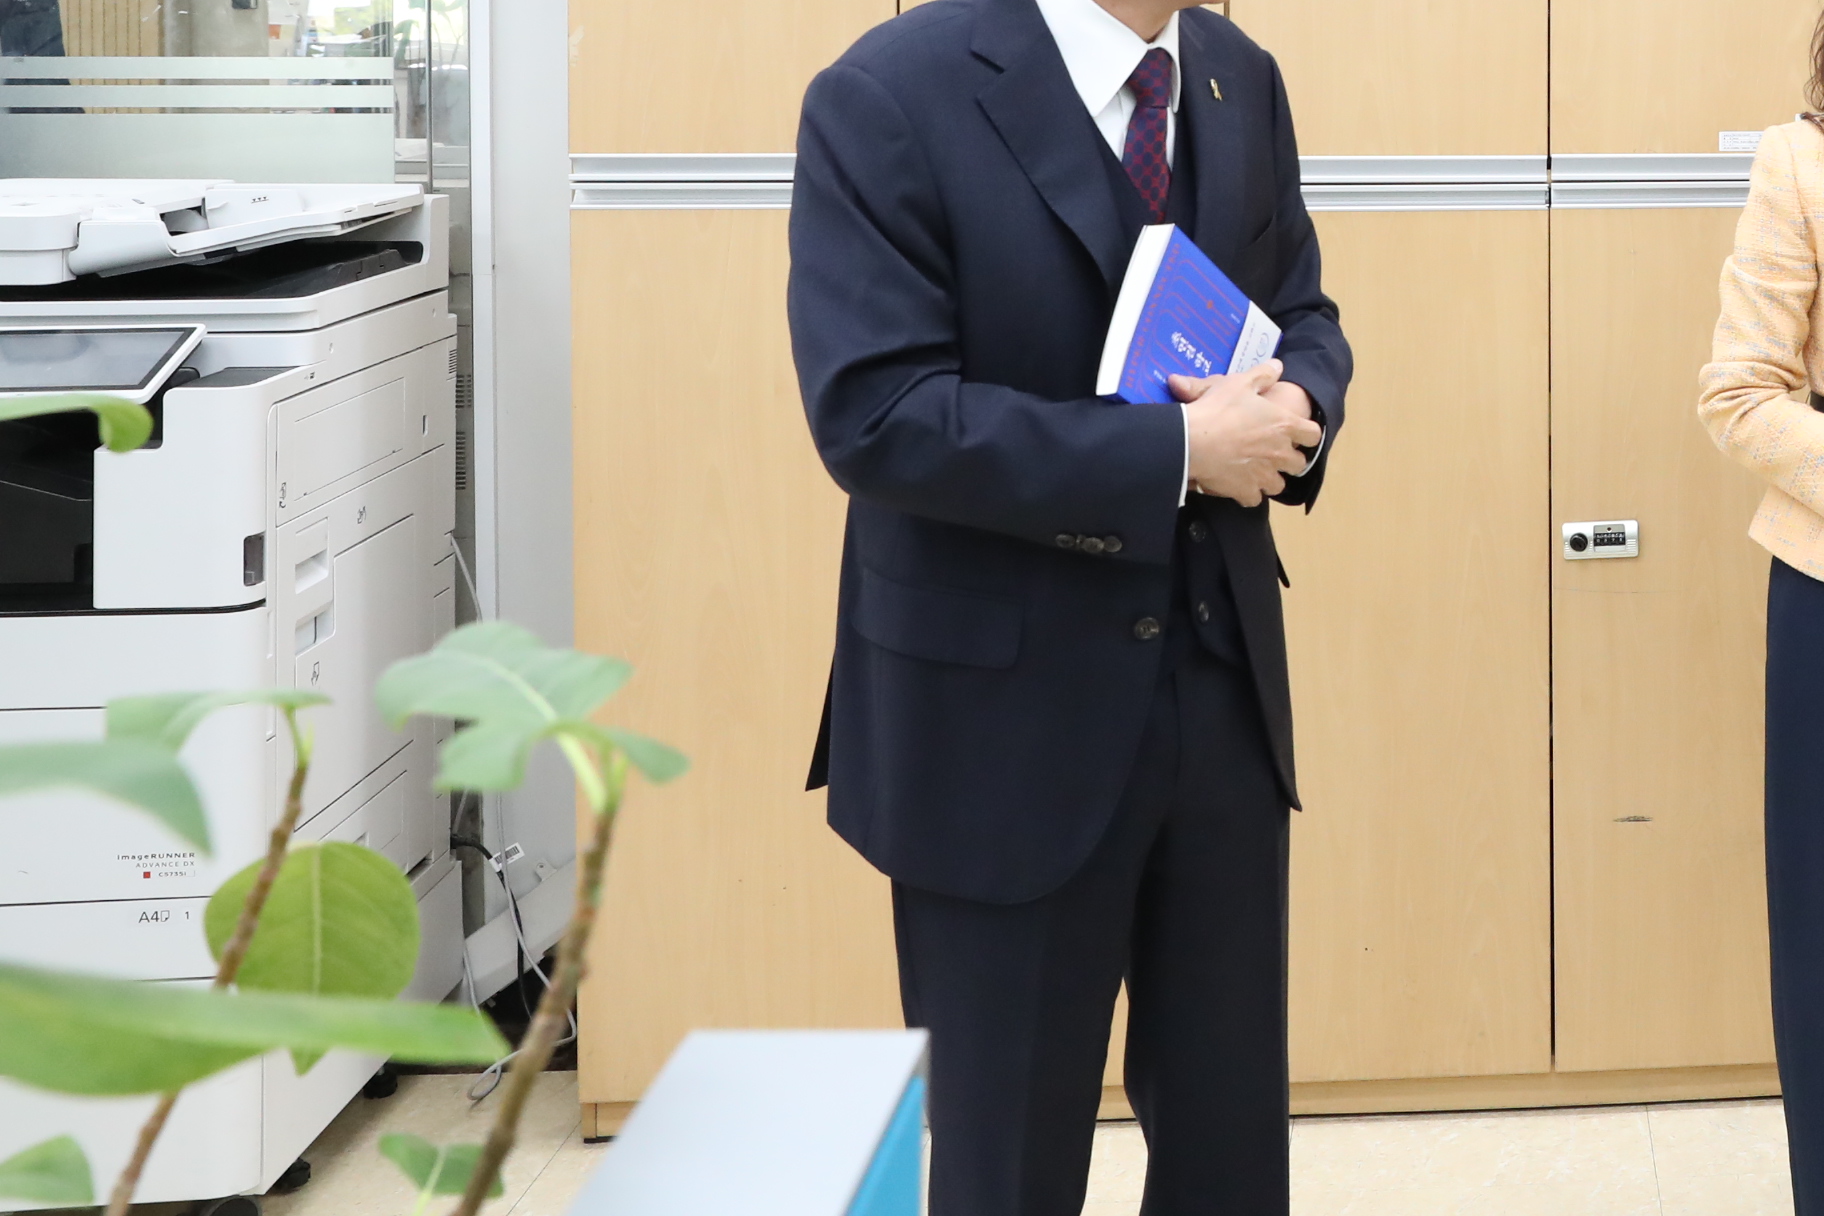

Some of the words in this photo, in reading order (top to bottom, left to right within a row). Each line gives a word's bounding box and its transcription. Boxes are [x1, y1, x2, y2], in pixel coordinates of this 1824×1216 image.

[117, 852, 195, 861] imageRUNNER
[136, 861, 180, 869] ADVANCE
[138, 911, 160, 924] A4
